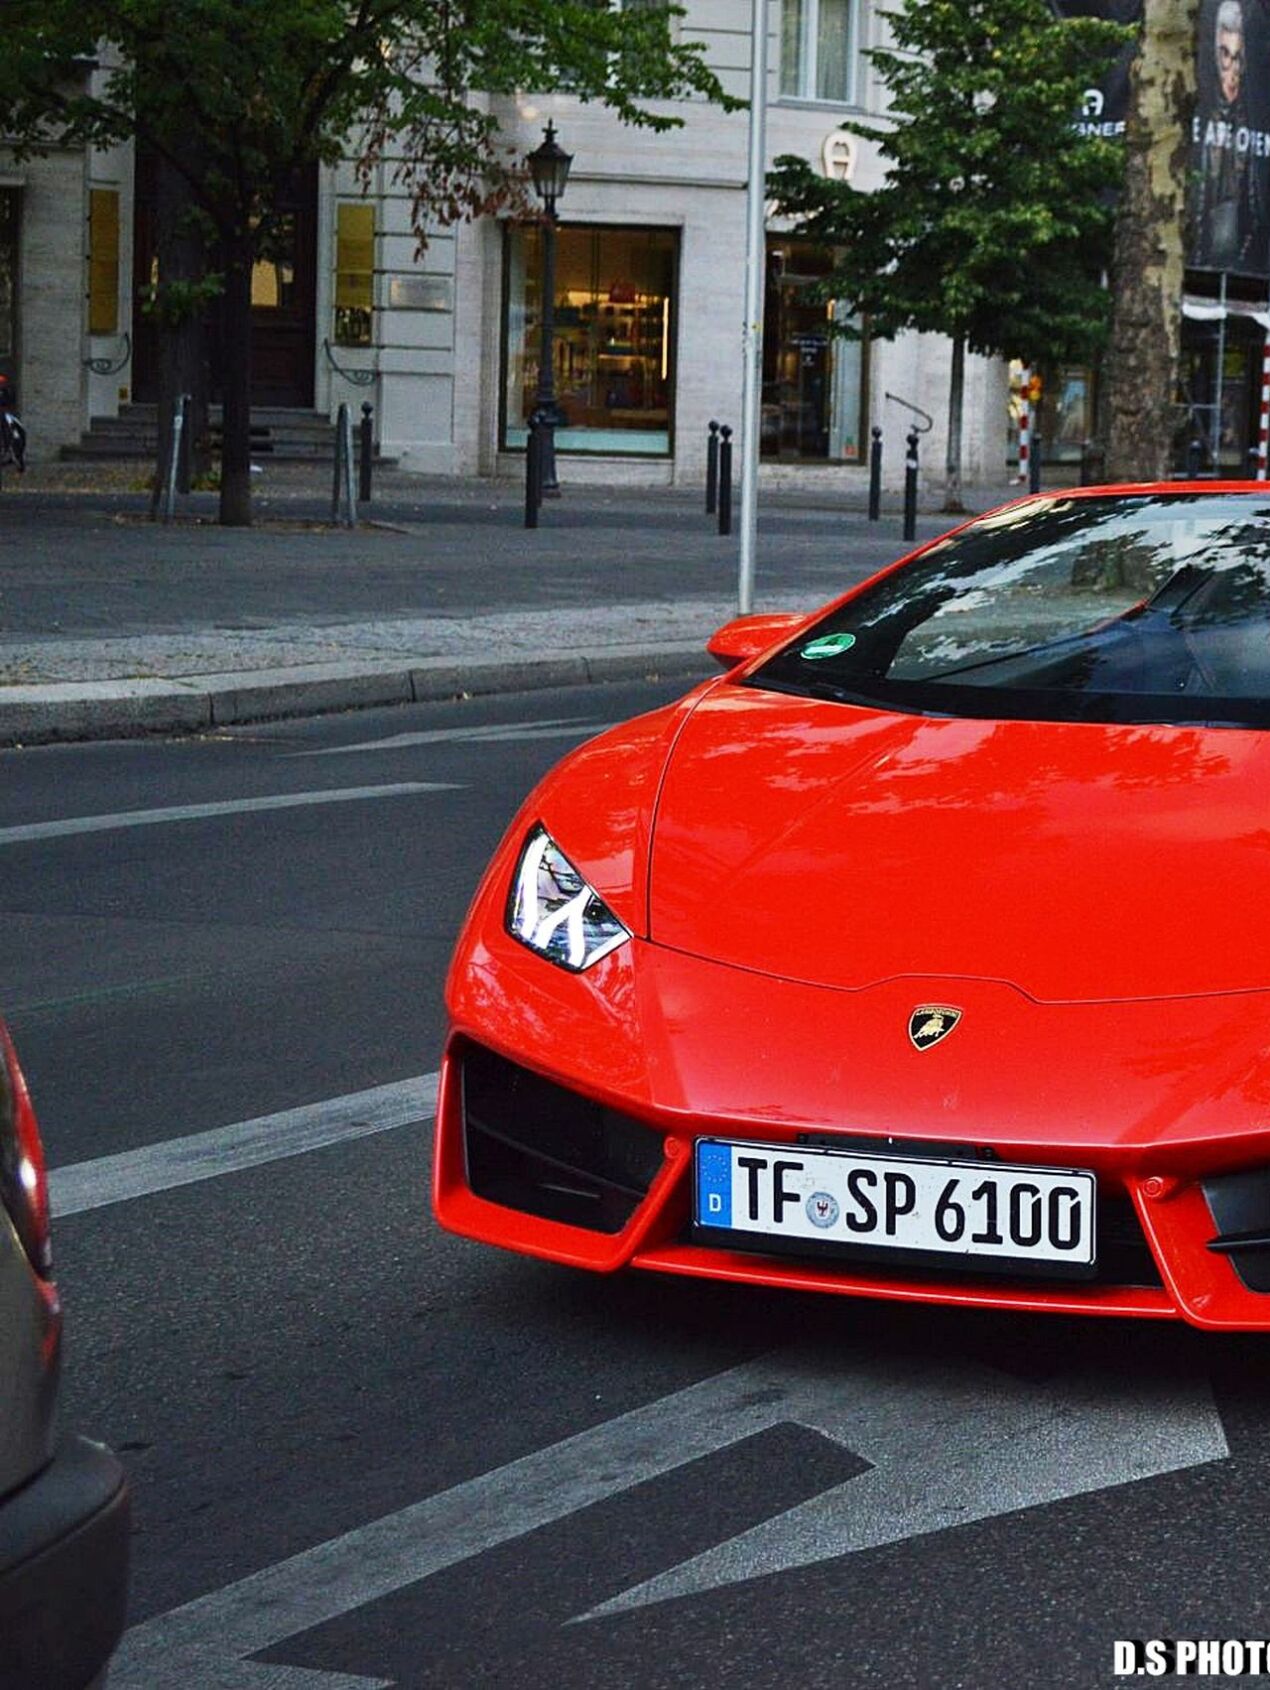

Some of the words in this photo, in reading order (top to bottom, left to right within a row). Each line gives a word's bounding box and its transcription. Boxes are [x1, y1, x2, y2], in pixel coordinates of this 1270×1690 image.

[709, 1193, 720, 1212] D
[738, 1156, 804, 1223] TF
[846, 1168, 917, 1236] SP
[934, 1178, 1080, 1250] 6100
